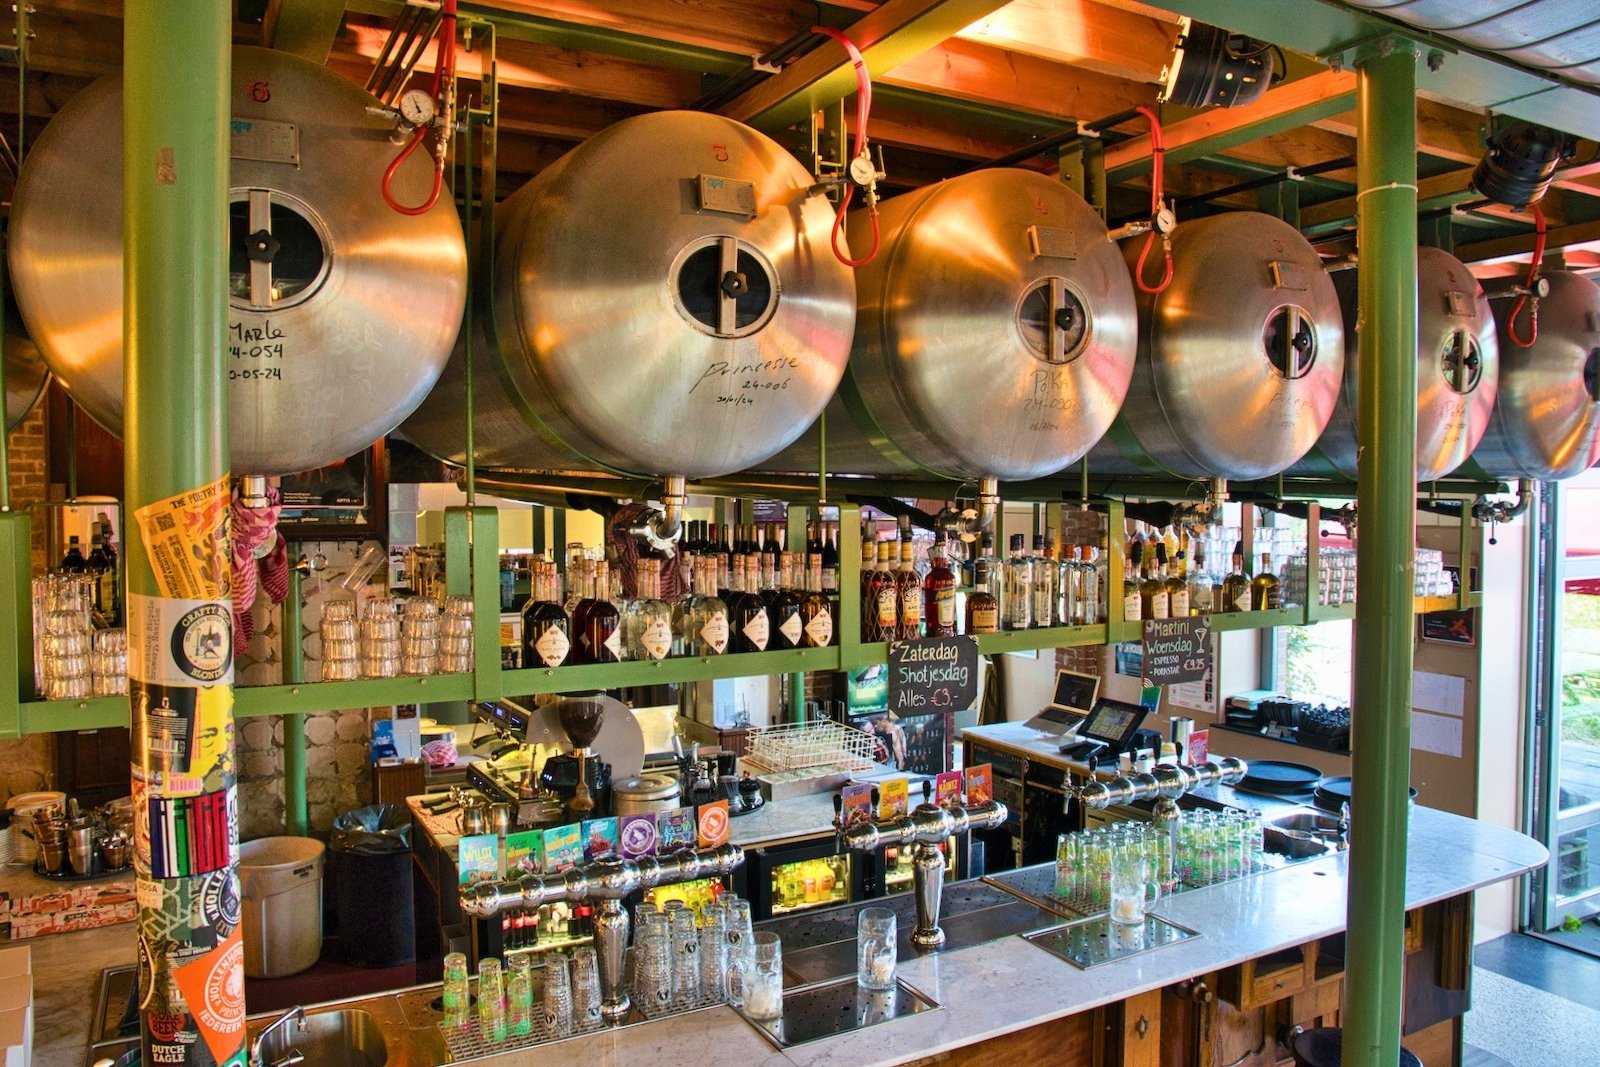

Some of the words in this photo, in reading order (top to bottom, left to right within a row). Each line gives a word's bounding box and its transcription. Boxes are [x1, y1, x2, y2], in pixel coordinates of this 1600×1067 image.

[247, 79, 270, 103] 6
[170, 497, 187, 510] THE
[188, 485, 217, 504] POETRY
[182, 606, 217, 627] CRAFTY
[1154, 620, 1190, 637] Martini
[900, 642, 958, 665] Zaterdag
[1146, 636, 1193, 657] Woensdag
[191, 666, 225, 680] BLONDE
[899, 661, 968, 688] Shotjesdag
[898, 689, 926, 708] Alles
[153, 1021, 178, 1033] BEER
[151, 1044, 185, 1054] DUTCH
[153, 1053, 185, 1062] EAGLE
